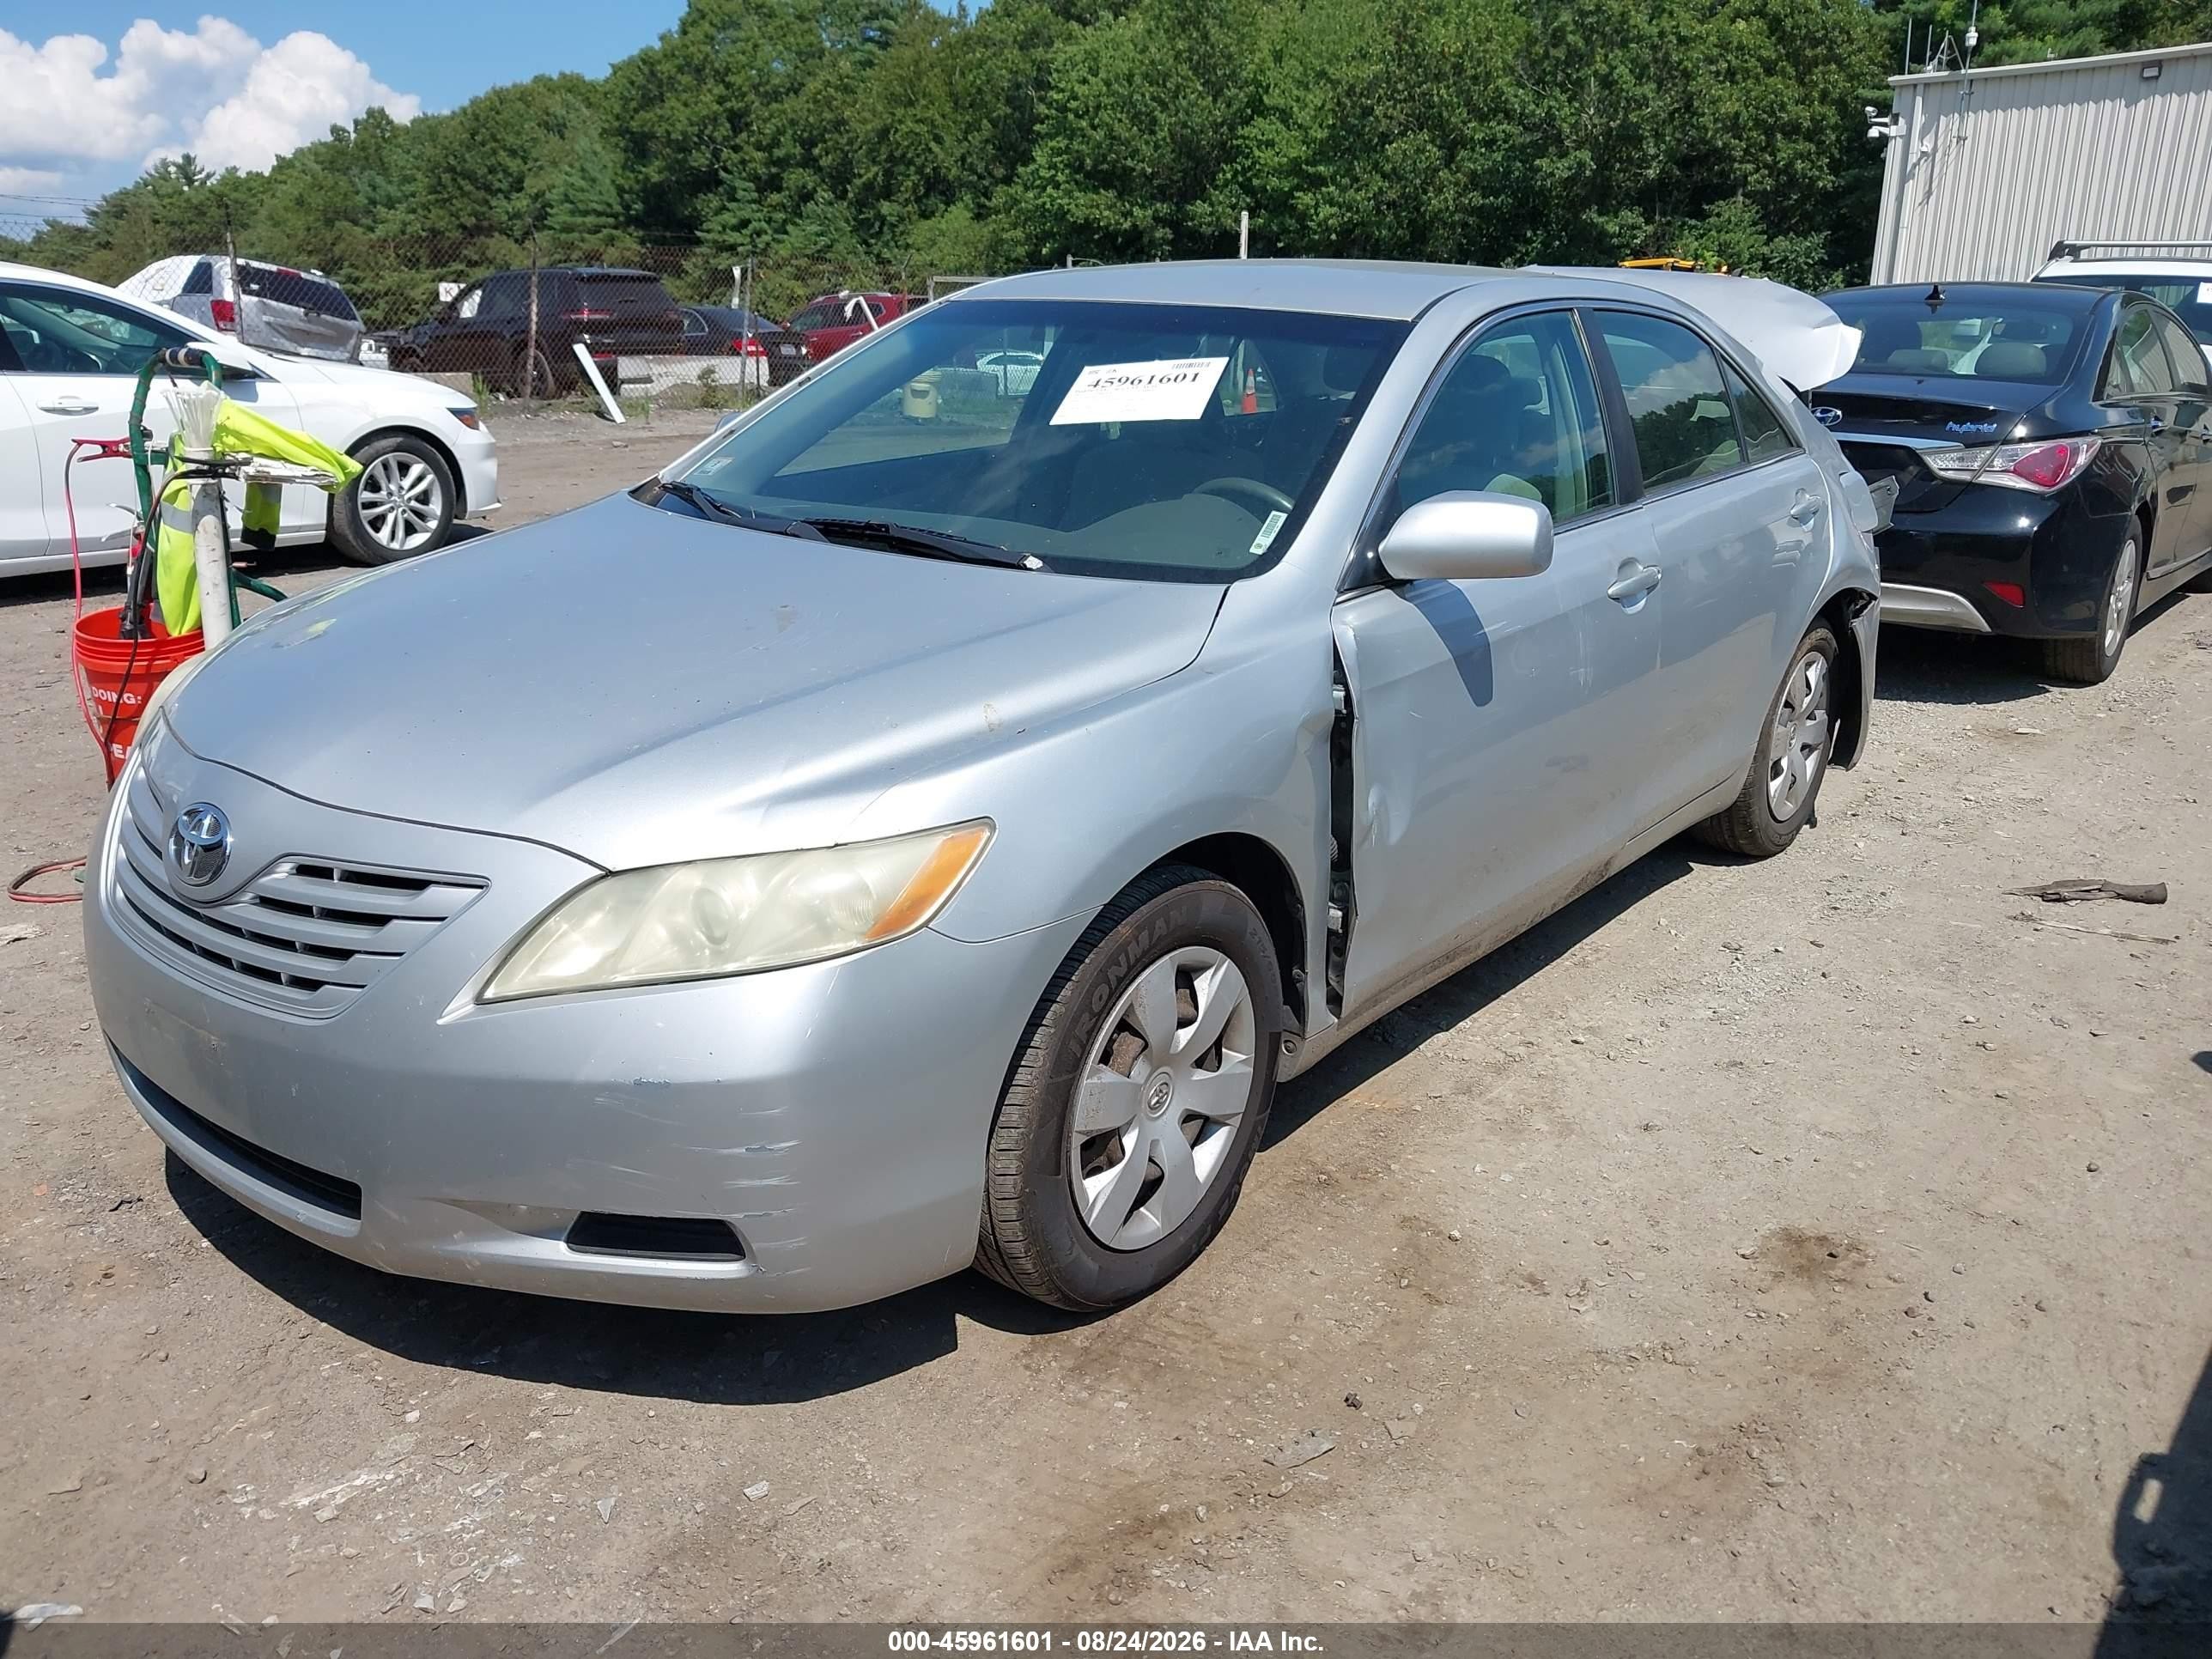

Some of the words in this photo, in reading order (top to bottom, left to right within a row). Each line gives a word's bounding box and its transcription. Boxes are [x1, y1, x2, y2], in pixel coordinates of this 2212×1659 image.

[1087, 372, 1200, 389] 45961601
[1945, 421, 1997, 434] hybrid
[1069, 905, 1188, 1058] IRONMAN
